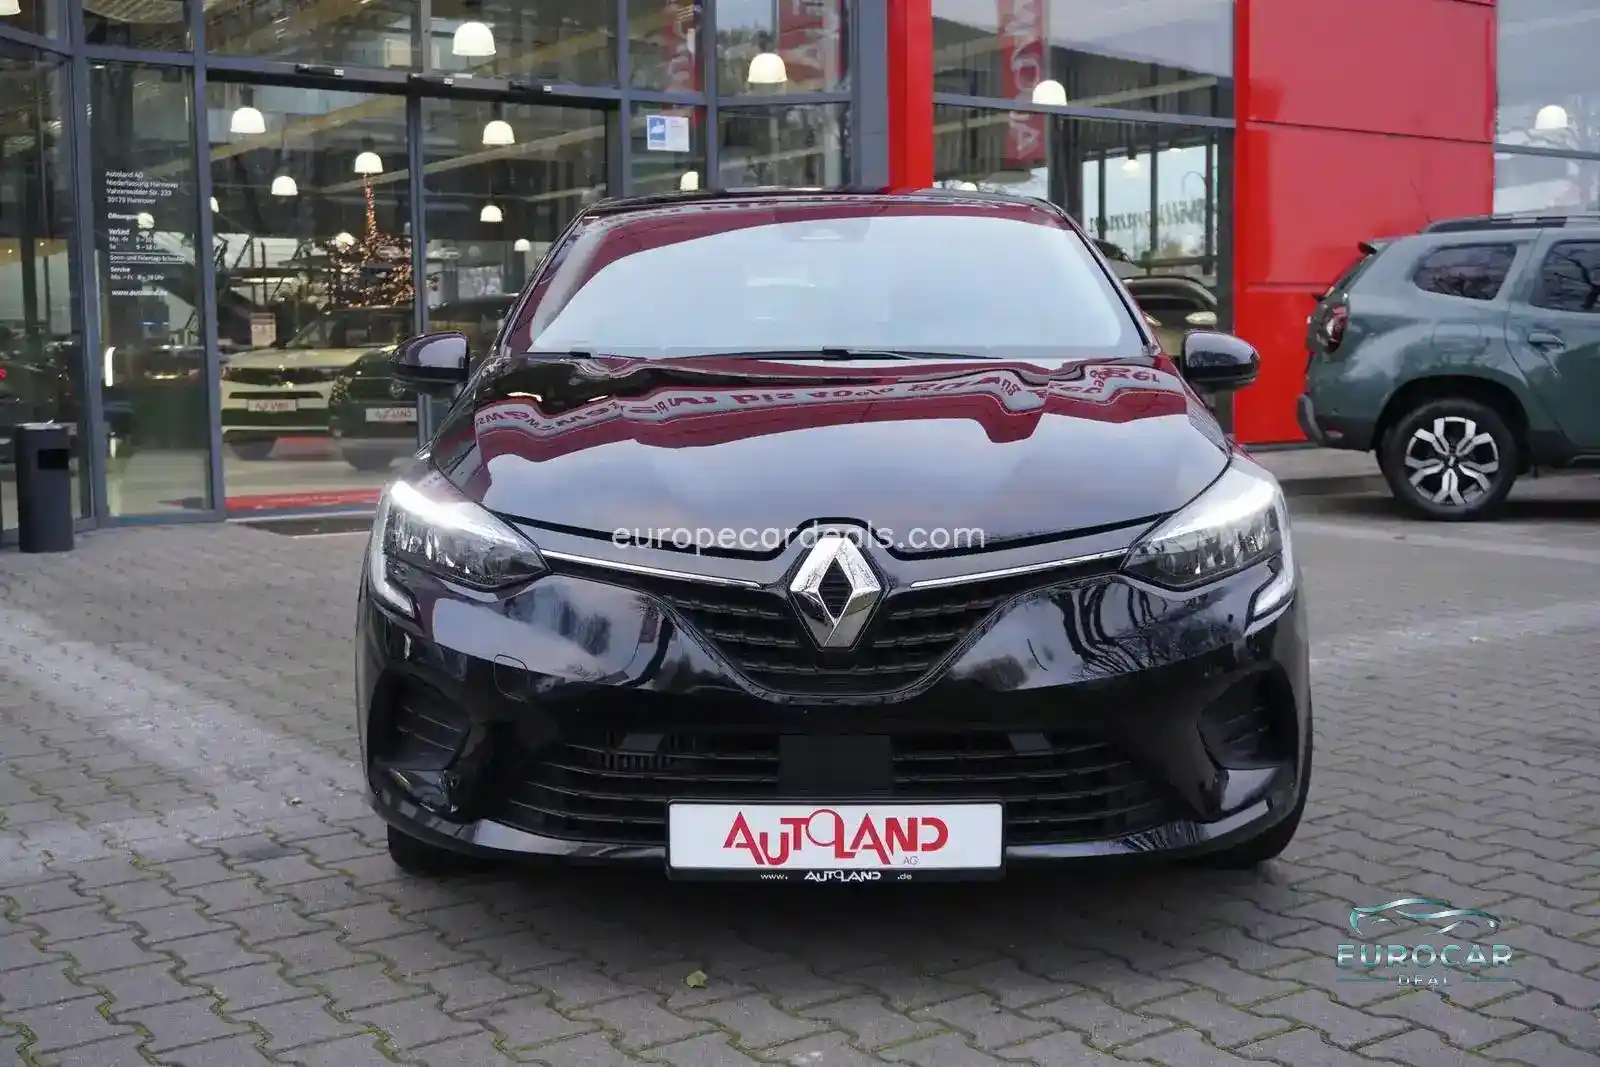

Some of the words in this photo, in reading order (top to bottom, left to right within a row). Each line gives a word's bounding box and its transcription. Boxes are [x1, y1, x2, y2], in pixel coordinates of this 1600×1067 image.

[723, 808, 949, 865] AUTOLAND
[903, 856, 919, 865] AG
[760, 873, 788, 881] www.
[804, 870, 881, 882] AUTOLAND
[897, 872, 912, 881] .de
